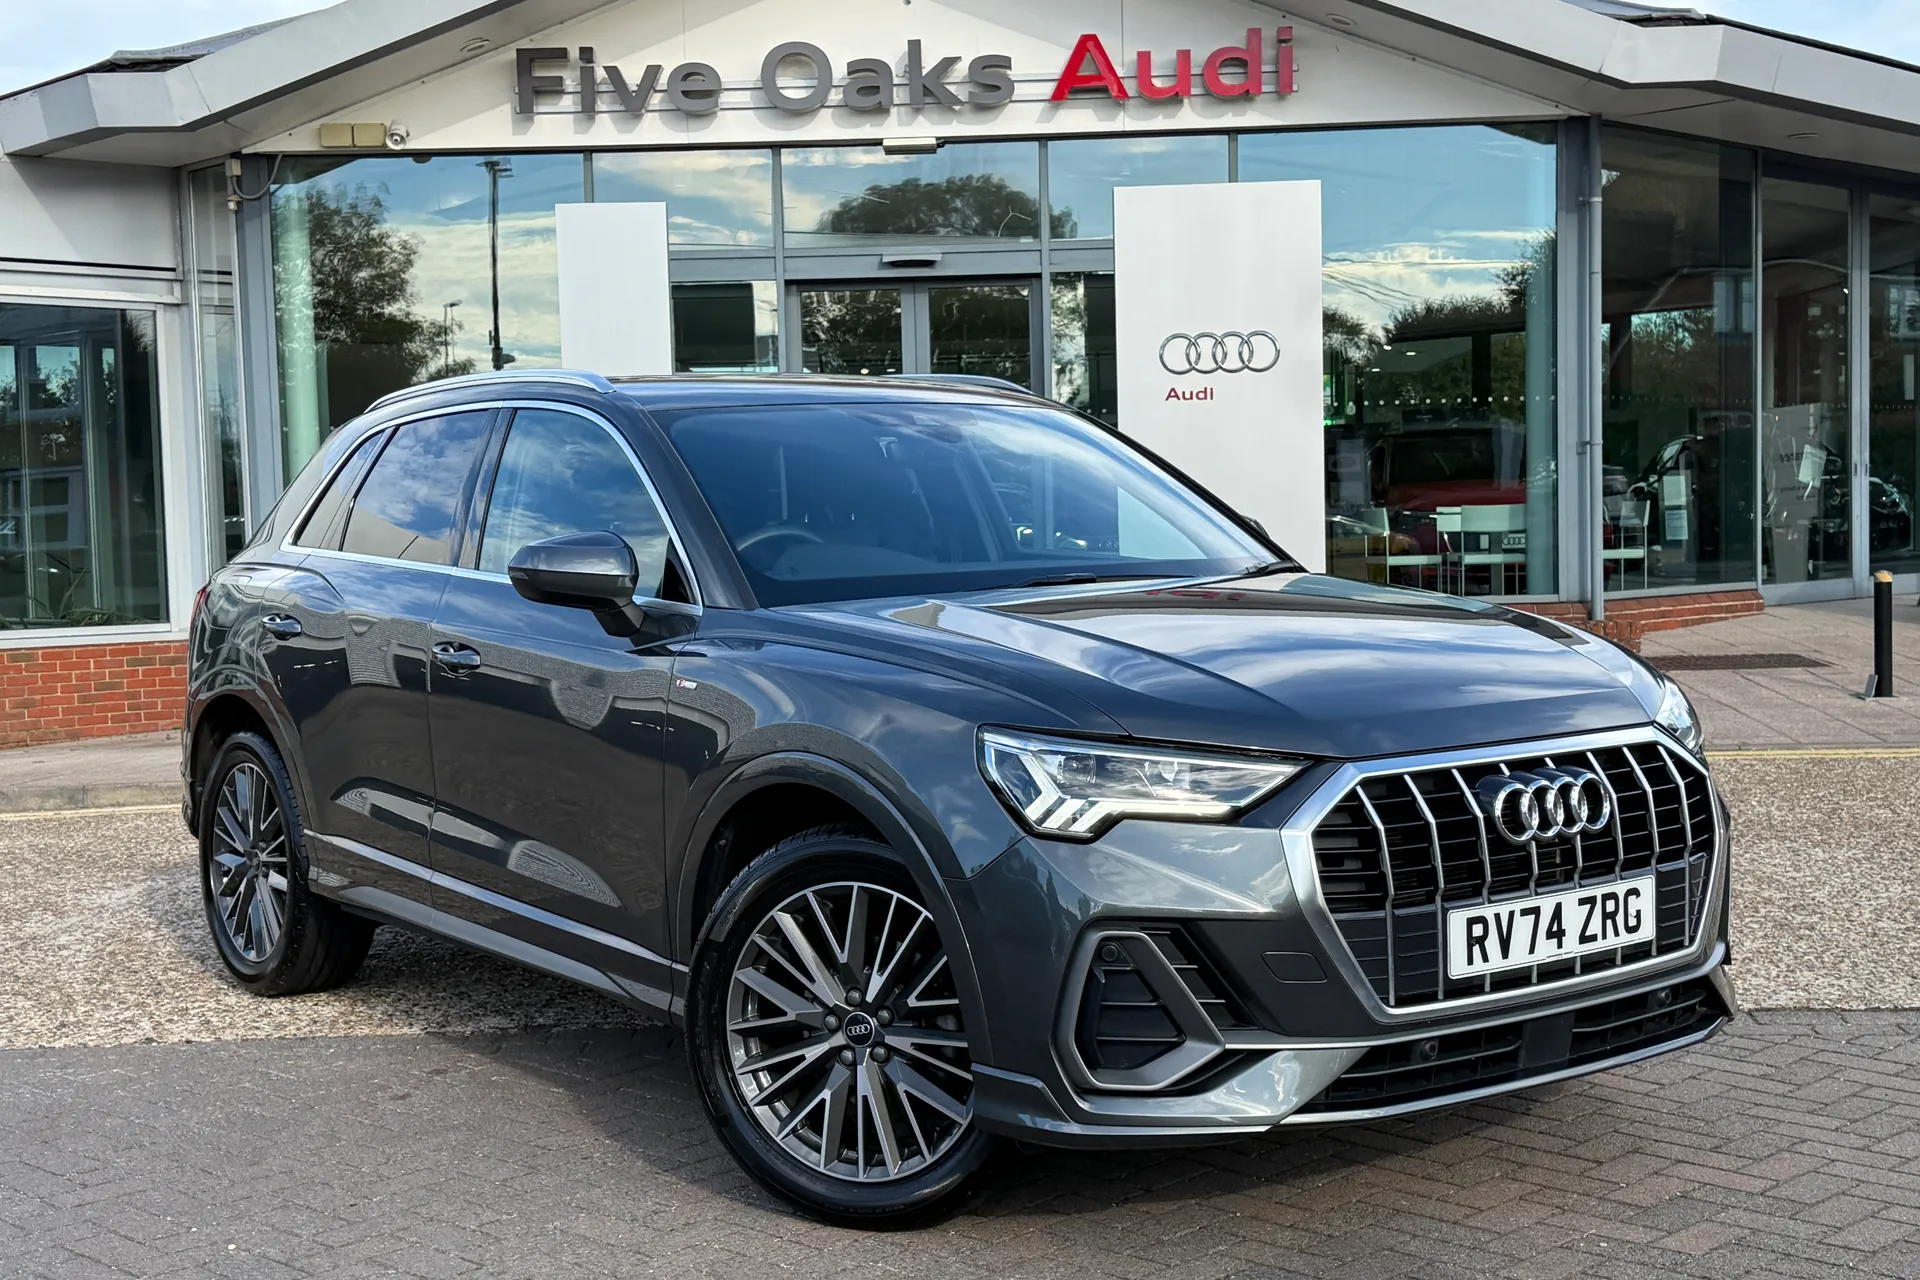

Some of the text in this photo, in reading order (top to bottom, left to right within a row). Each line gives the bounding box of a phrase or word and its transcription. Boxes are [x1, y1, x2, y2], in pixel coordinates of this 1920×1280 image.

[515, 26, 1293, 115] Five Oaks Audi
[1165, 386, 1214, 401] Audi
[1466, 887, 1641, 966] RV74 ZRG
